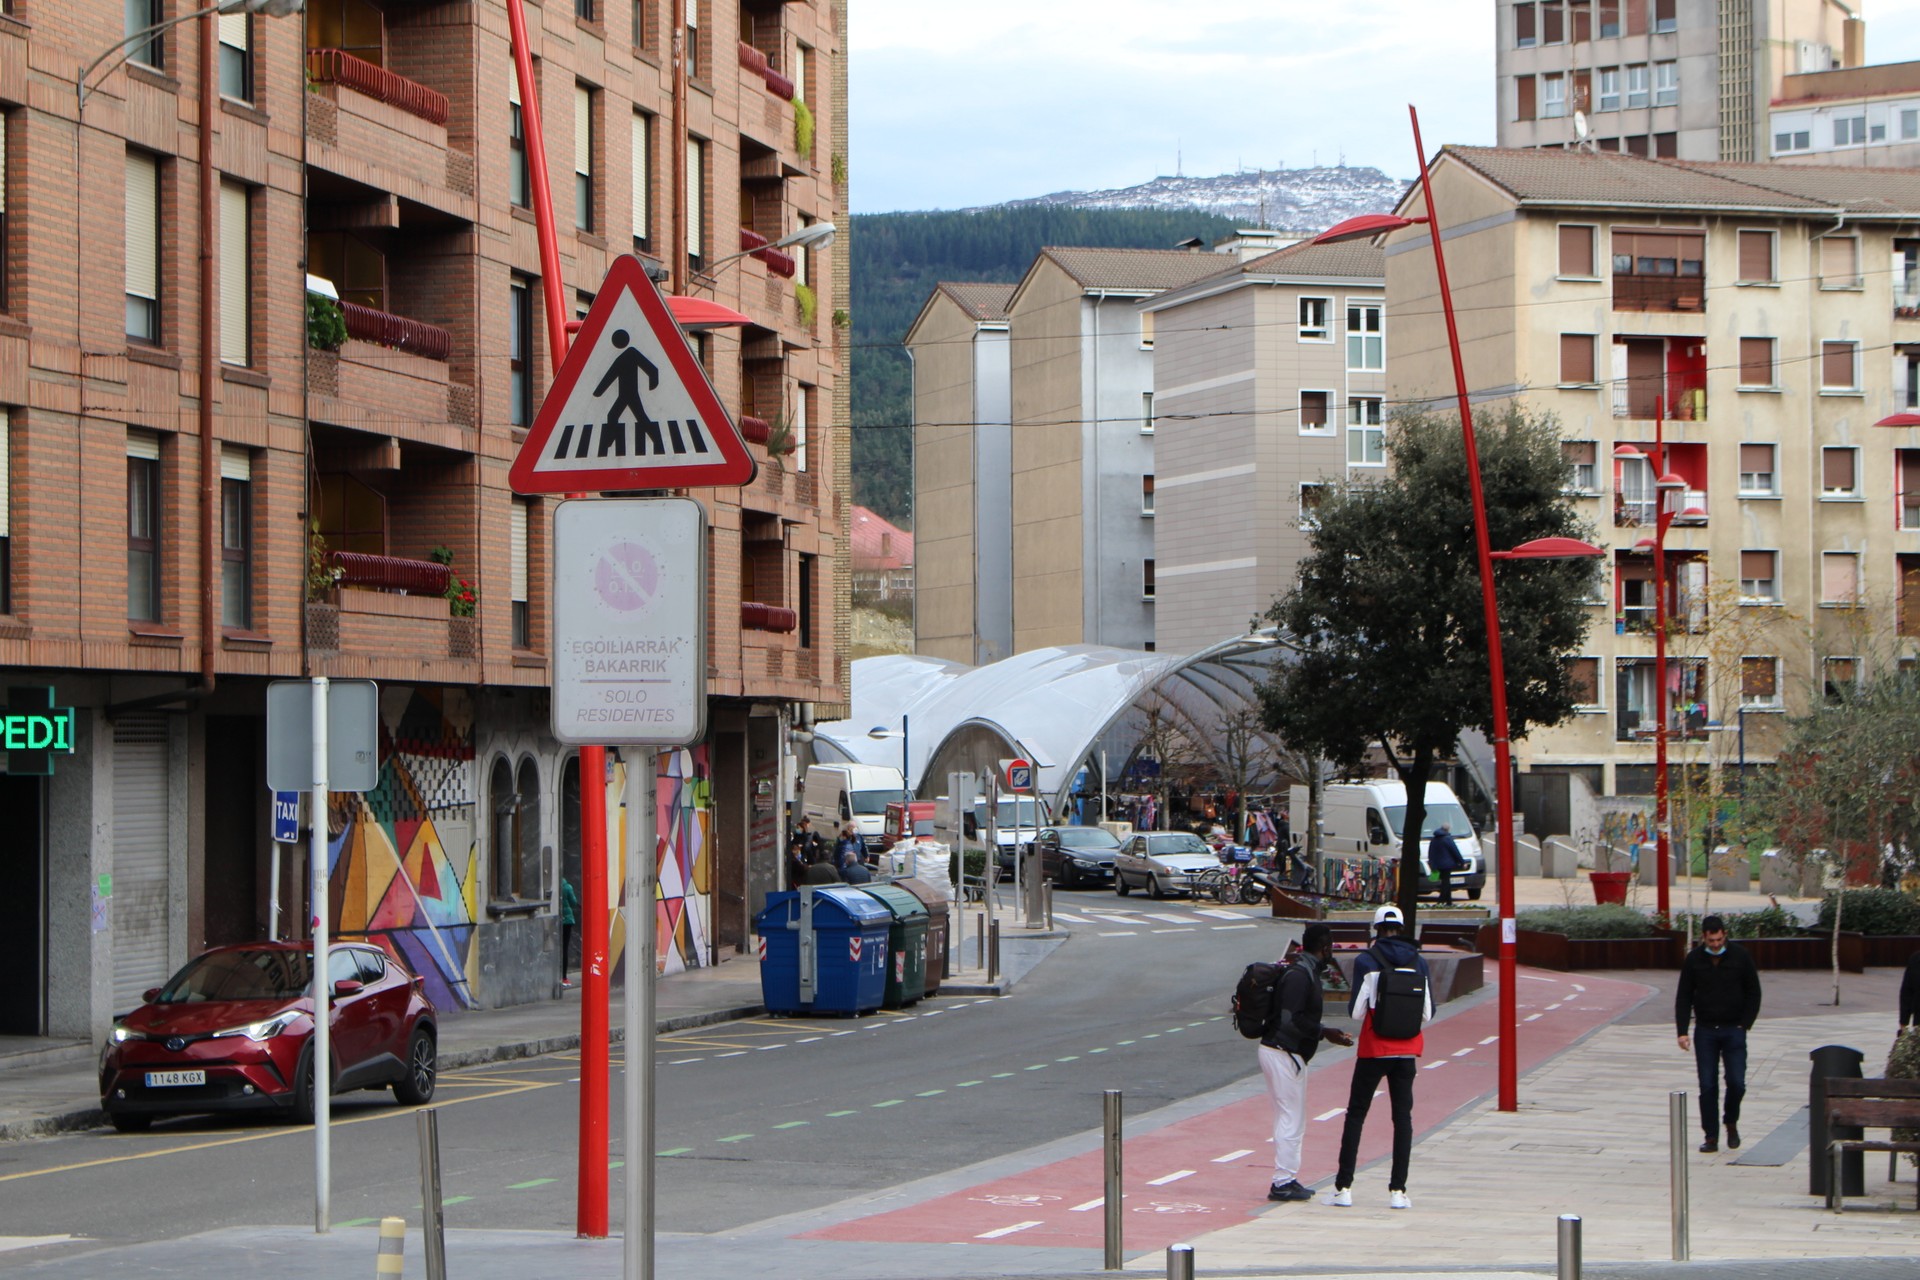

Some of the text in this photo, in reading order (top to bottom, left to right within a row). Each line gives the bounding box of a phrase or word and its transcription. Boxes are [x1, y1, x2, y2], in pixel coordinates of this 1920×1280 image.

[572, 640, 679, 654] EGOILIARRAK
[585, 659, 667, 673] BAKARRIK
[604, 689, 647, 703] SOLO
[576, 708, 676, 722] RESIDENTES
[276, 801, 298, 821] TAXI
[154, 1072, 202, 1085] 1148 KGX
